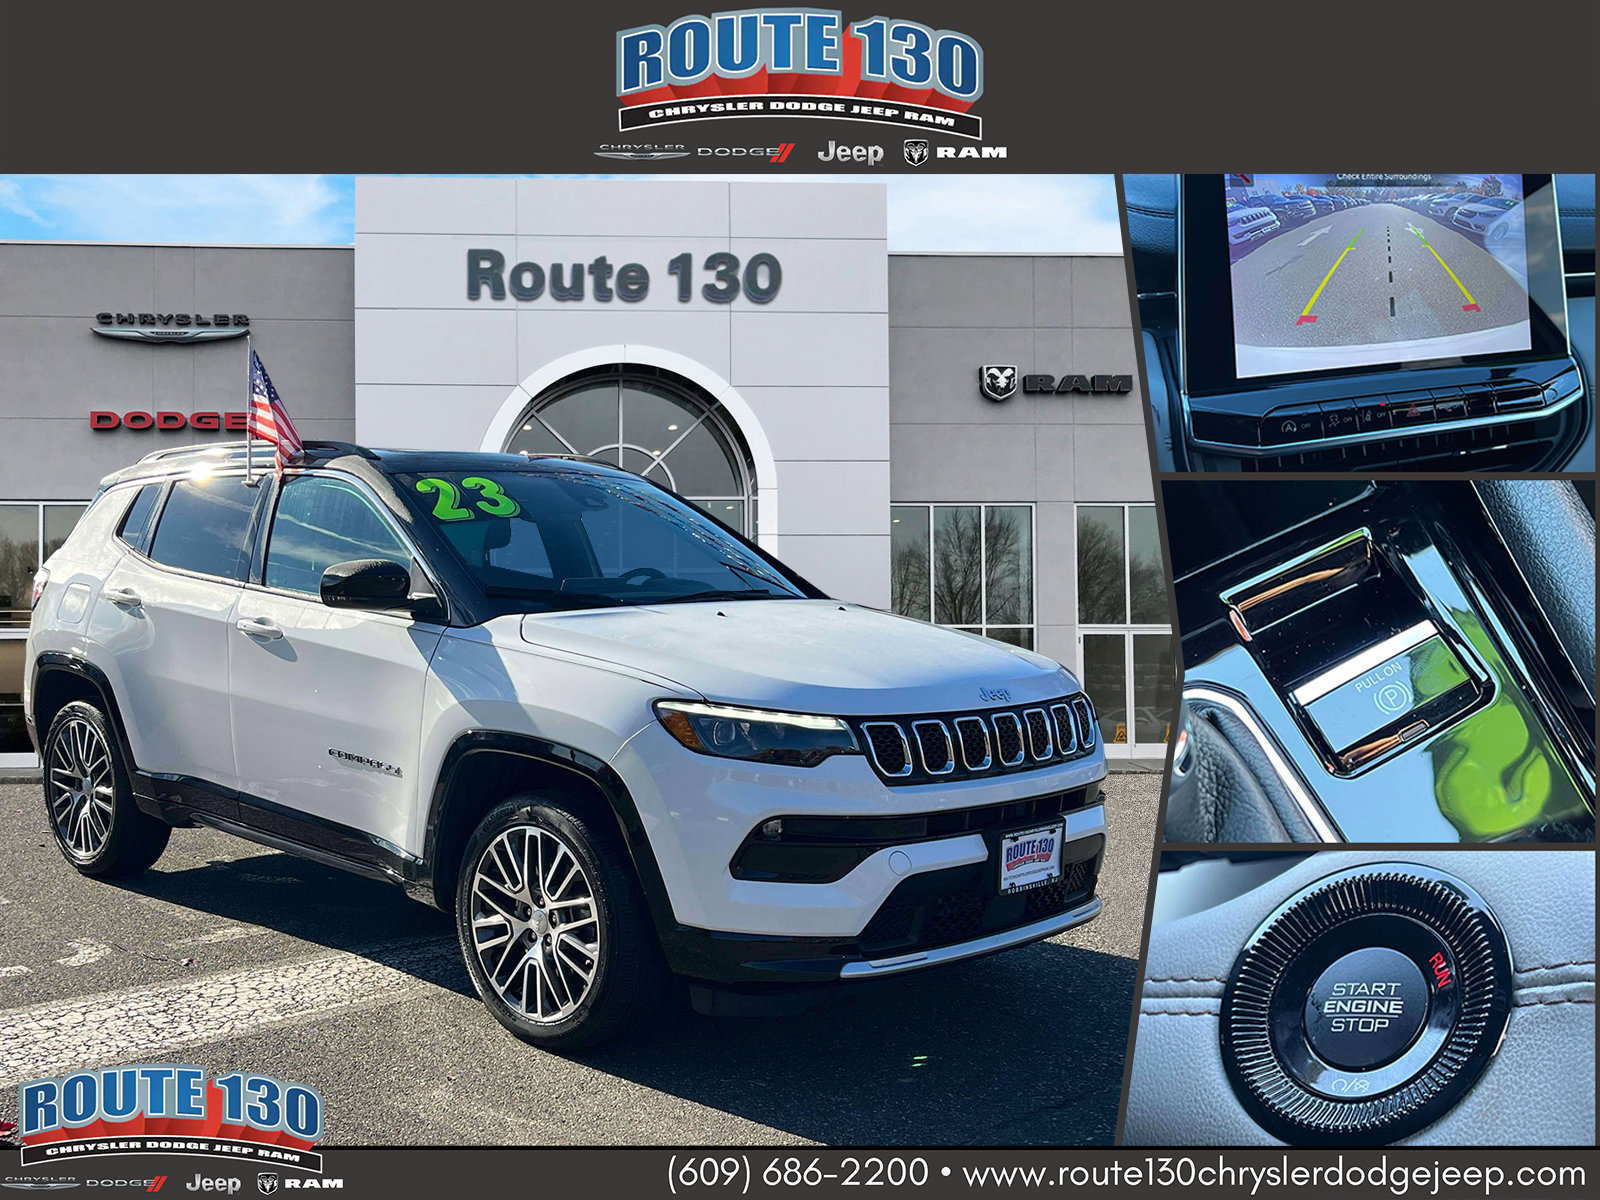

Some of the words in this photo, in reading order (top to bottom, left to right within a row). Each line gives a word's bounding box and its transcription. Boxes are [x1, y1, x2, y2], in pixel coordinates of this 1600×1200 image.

[467, 248, 650, 303] Route
[668, 251, 783, 305] 130
[95, 312, 250, 327] CHRYSLER
[1022, 373, 1134, 395] RAM
[89, 410, 249, 432] DODGE
[415, 476, 521, 521] 23
[1354, 673, 1385, 693] PULL
[1383, 661, 1404, 678] ON
[979, 686, 1012, 703] Jeep
[1006, 840, 1037, 863] ROUTE
[1038, 838, 1055, 854] 130
[1428, 951, 1453, 989] RUN
[1331, 982, 1402, 996] START
[1322, 1000, 1405, 1014] ENGINE
[1330, 1017, 1390, 1033] STOP
